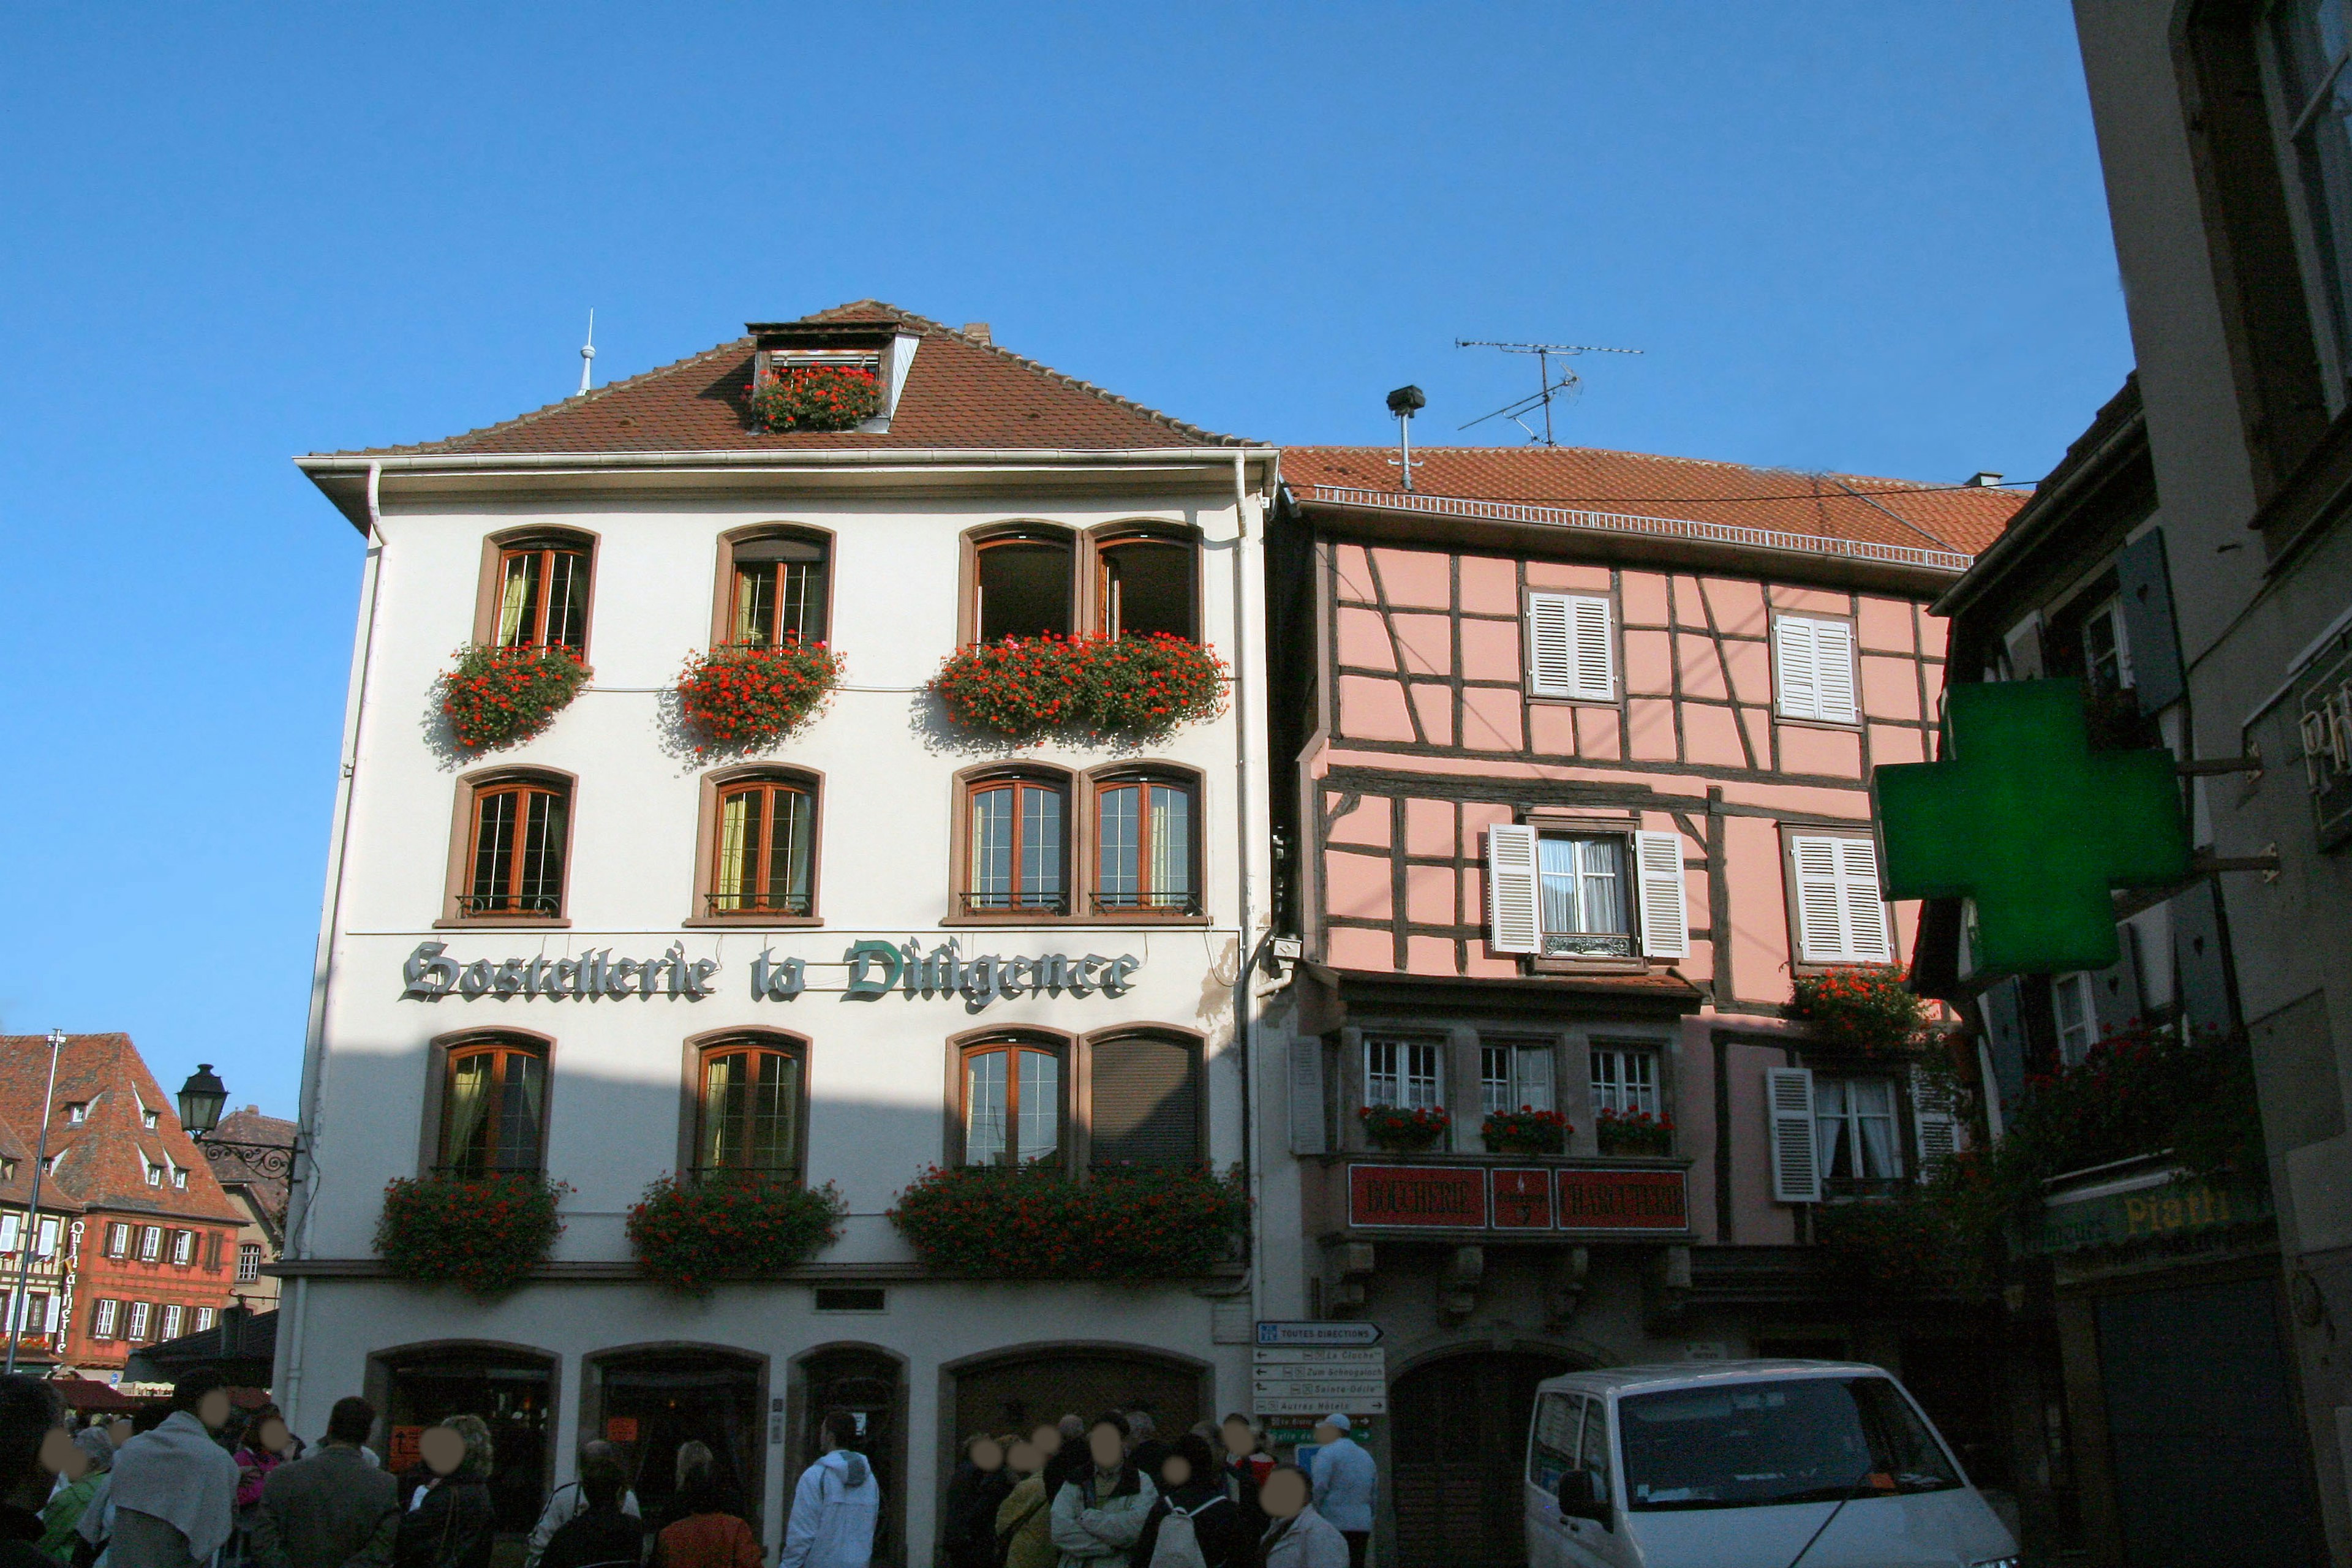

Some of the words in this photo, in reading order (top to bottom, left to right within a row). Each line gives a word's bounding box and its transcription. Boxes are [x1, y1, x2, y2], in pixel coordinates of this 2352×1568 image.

[752, 947, 805, 995] la
[844, 936, 1139, 1009] Diligence
[1281, 1329, 1314, 1338] TOUTES
[1317, 1329, 1370, 1338] DIRECTIONS
